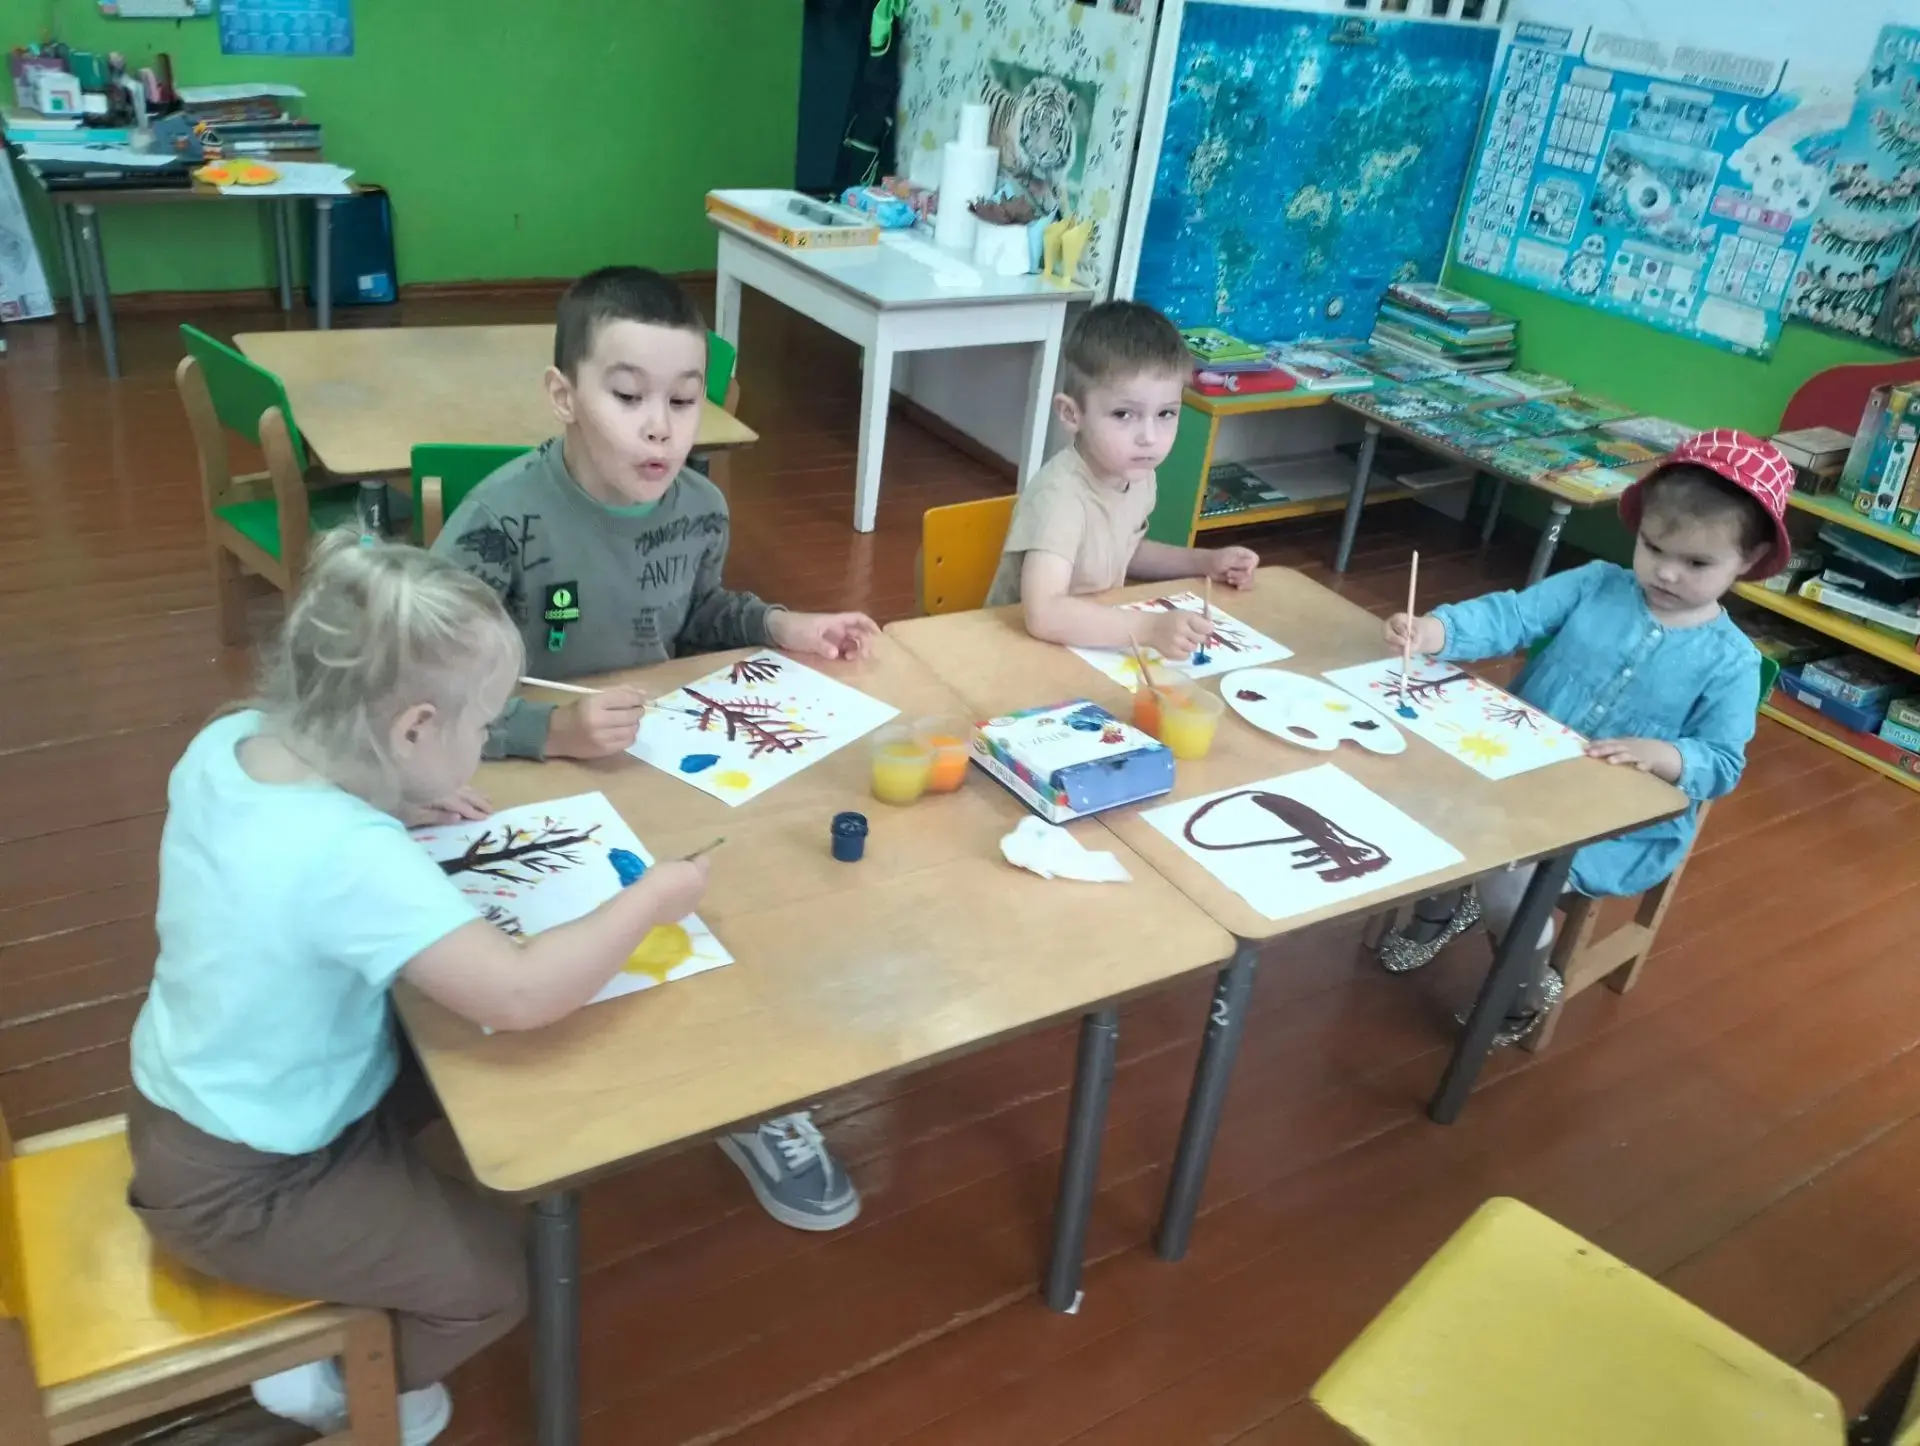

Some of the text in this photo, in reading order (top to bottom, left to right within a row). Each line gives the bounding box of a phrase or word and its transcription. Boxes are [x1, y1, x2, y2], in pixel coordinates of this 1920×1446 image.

[1548, 524, 1560, 542] 2
[637, 553, 688, 591] ANTI
[1210, 999, 1230, 1026] 2
